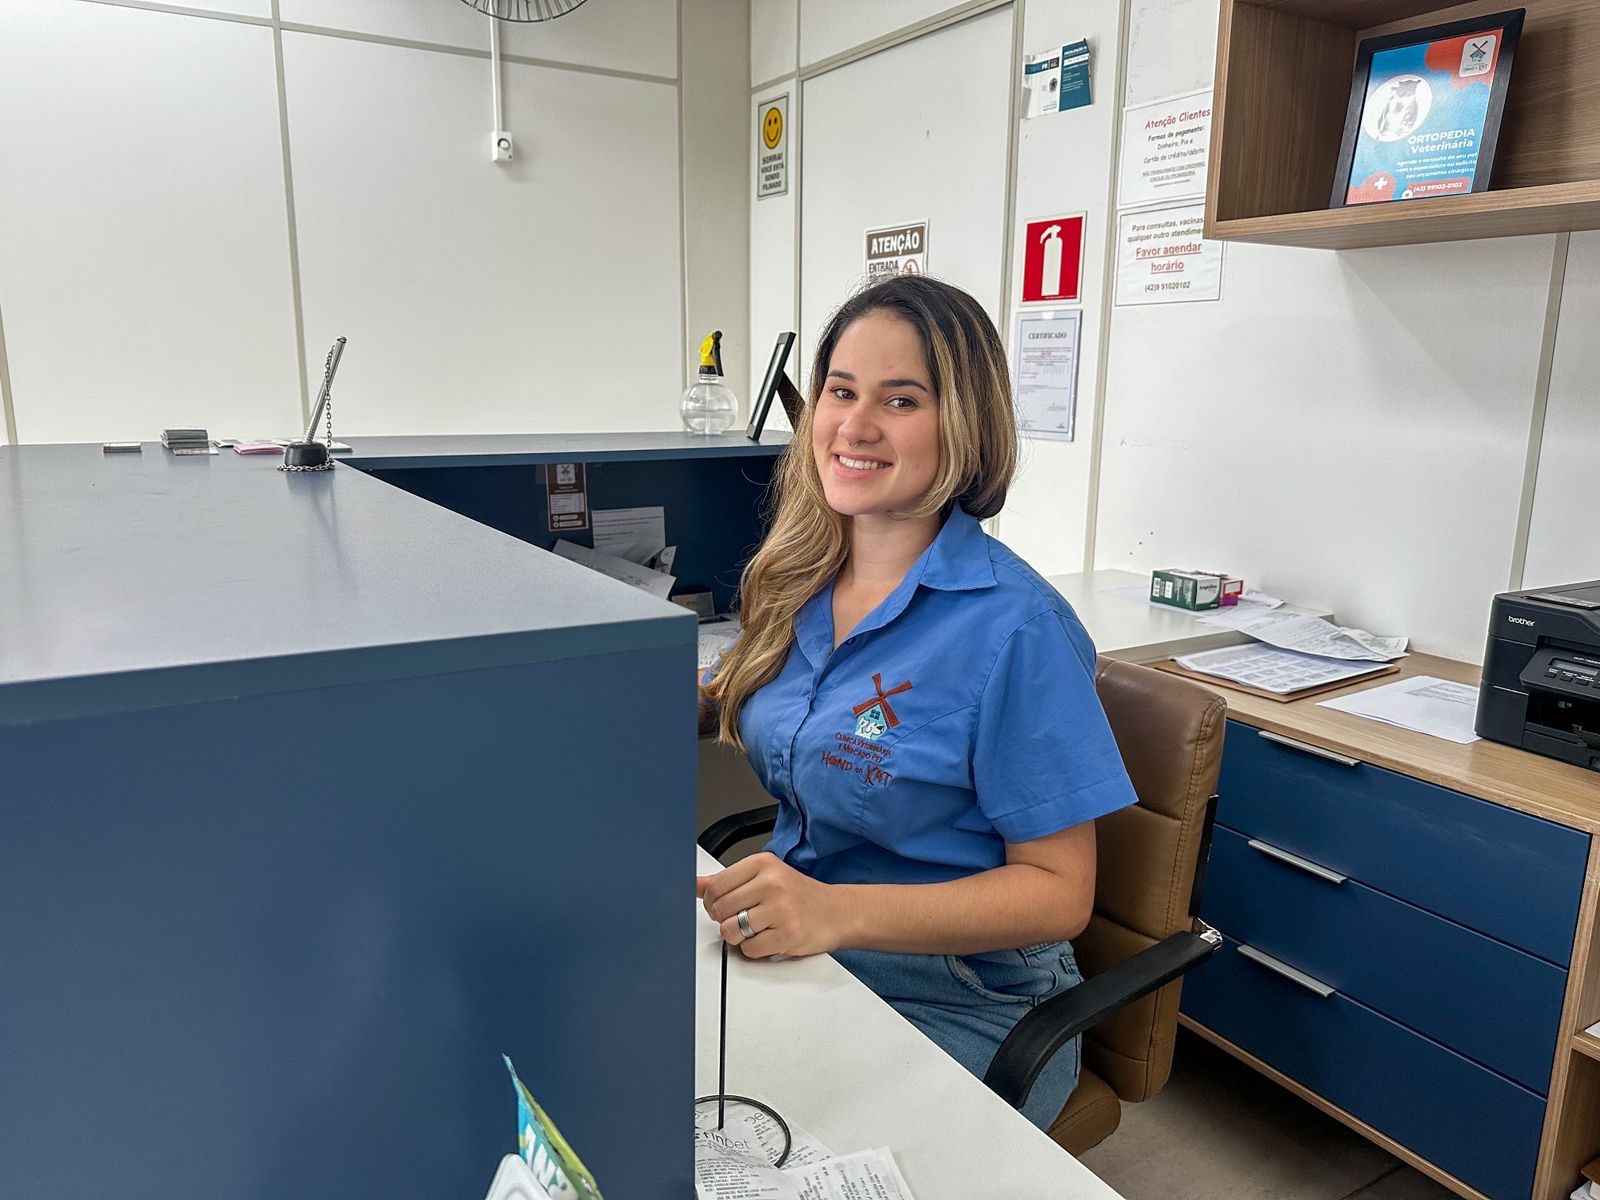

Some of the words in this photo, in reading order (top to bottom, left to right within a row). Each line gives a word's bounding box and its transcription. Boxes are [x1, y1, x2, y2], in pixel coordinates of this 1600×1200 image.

[1145, 115, 1176, 129] Atenção
[1179, 109, 1211, 122] Clientes
[1148, 134, 1166, 142] Formas
[1408, 128, 1476, 144] ORTOPEDIA
[1411, 139, 1473, 154] Veterinária
[1161, 152, 1167, 160] de
[1413, 185, 1426, 193] (42)
[1427, 181, 1463, 191] 99102-0102
[1132, 224, 1146, 232] Para
[871, 230, 920, 256] ATENÇÃO
[1128, 233, 1152, 243] qualquer
[1153, 231, 1171, 240] outro
[1136, 247, 1161, 258] Favor
[1163, 242, 1202, 256] agendar
[869, 260, 899, 275] ENTRADA
[1151, 260, 1184, 272] horário
[1161, 281, 1191, 291] 91020102
[1028, 332, 1067, 340] CERTIFICADO
[1508, 616, 1535, 627] brother
